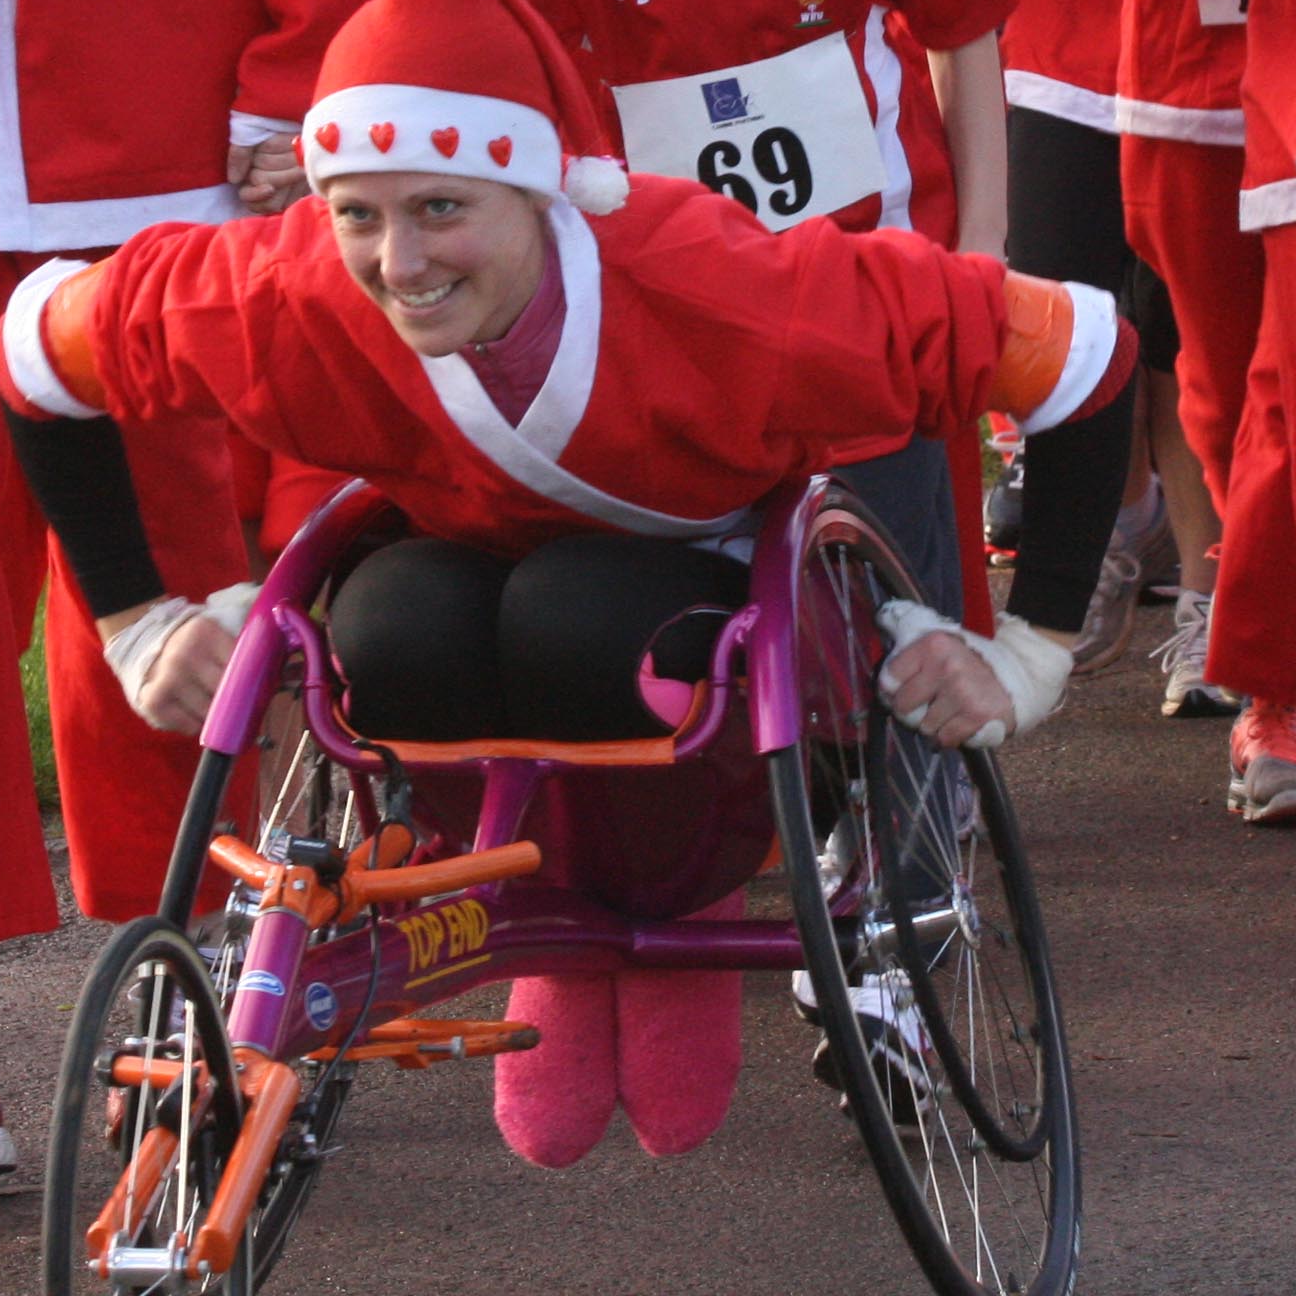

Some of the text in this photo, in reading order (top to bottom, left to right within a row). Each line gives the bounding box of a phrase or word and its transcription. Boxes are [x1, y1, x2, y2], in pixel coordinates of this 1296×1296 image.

[697, 126, 813, 217] 69
[399, 899, 489, 975] TOP END
